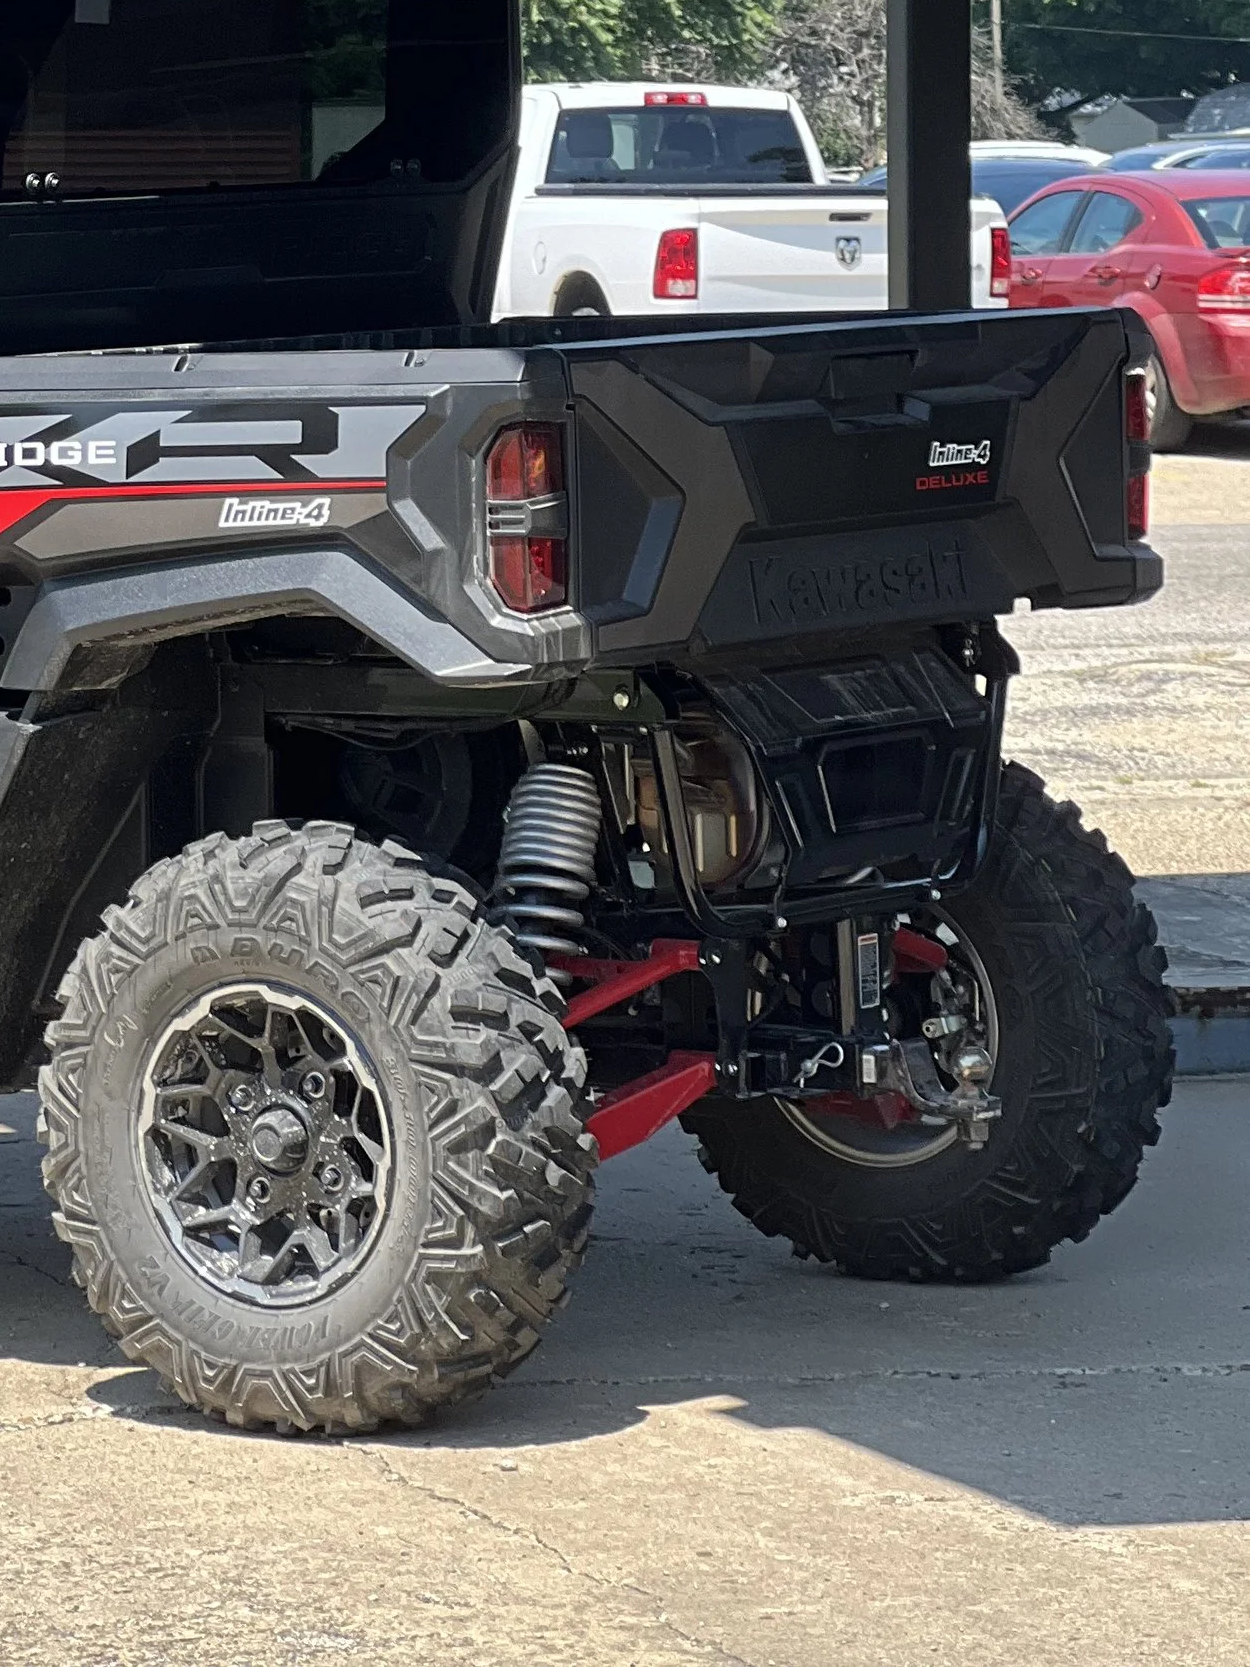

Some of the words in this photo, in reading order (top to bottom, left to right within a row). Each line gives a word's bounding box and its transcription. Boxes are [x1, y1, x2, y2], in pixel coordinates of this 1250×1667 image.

[928, 439, 991, 467] Inline-4
[915, 470, 990, 490] DELUXE
[218, 497, 331, 528] Inline-4
